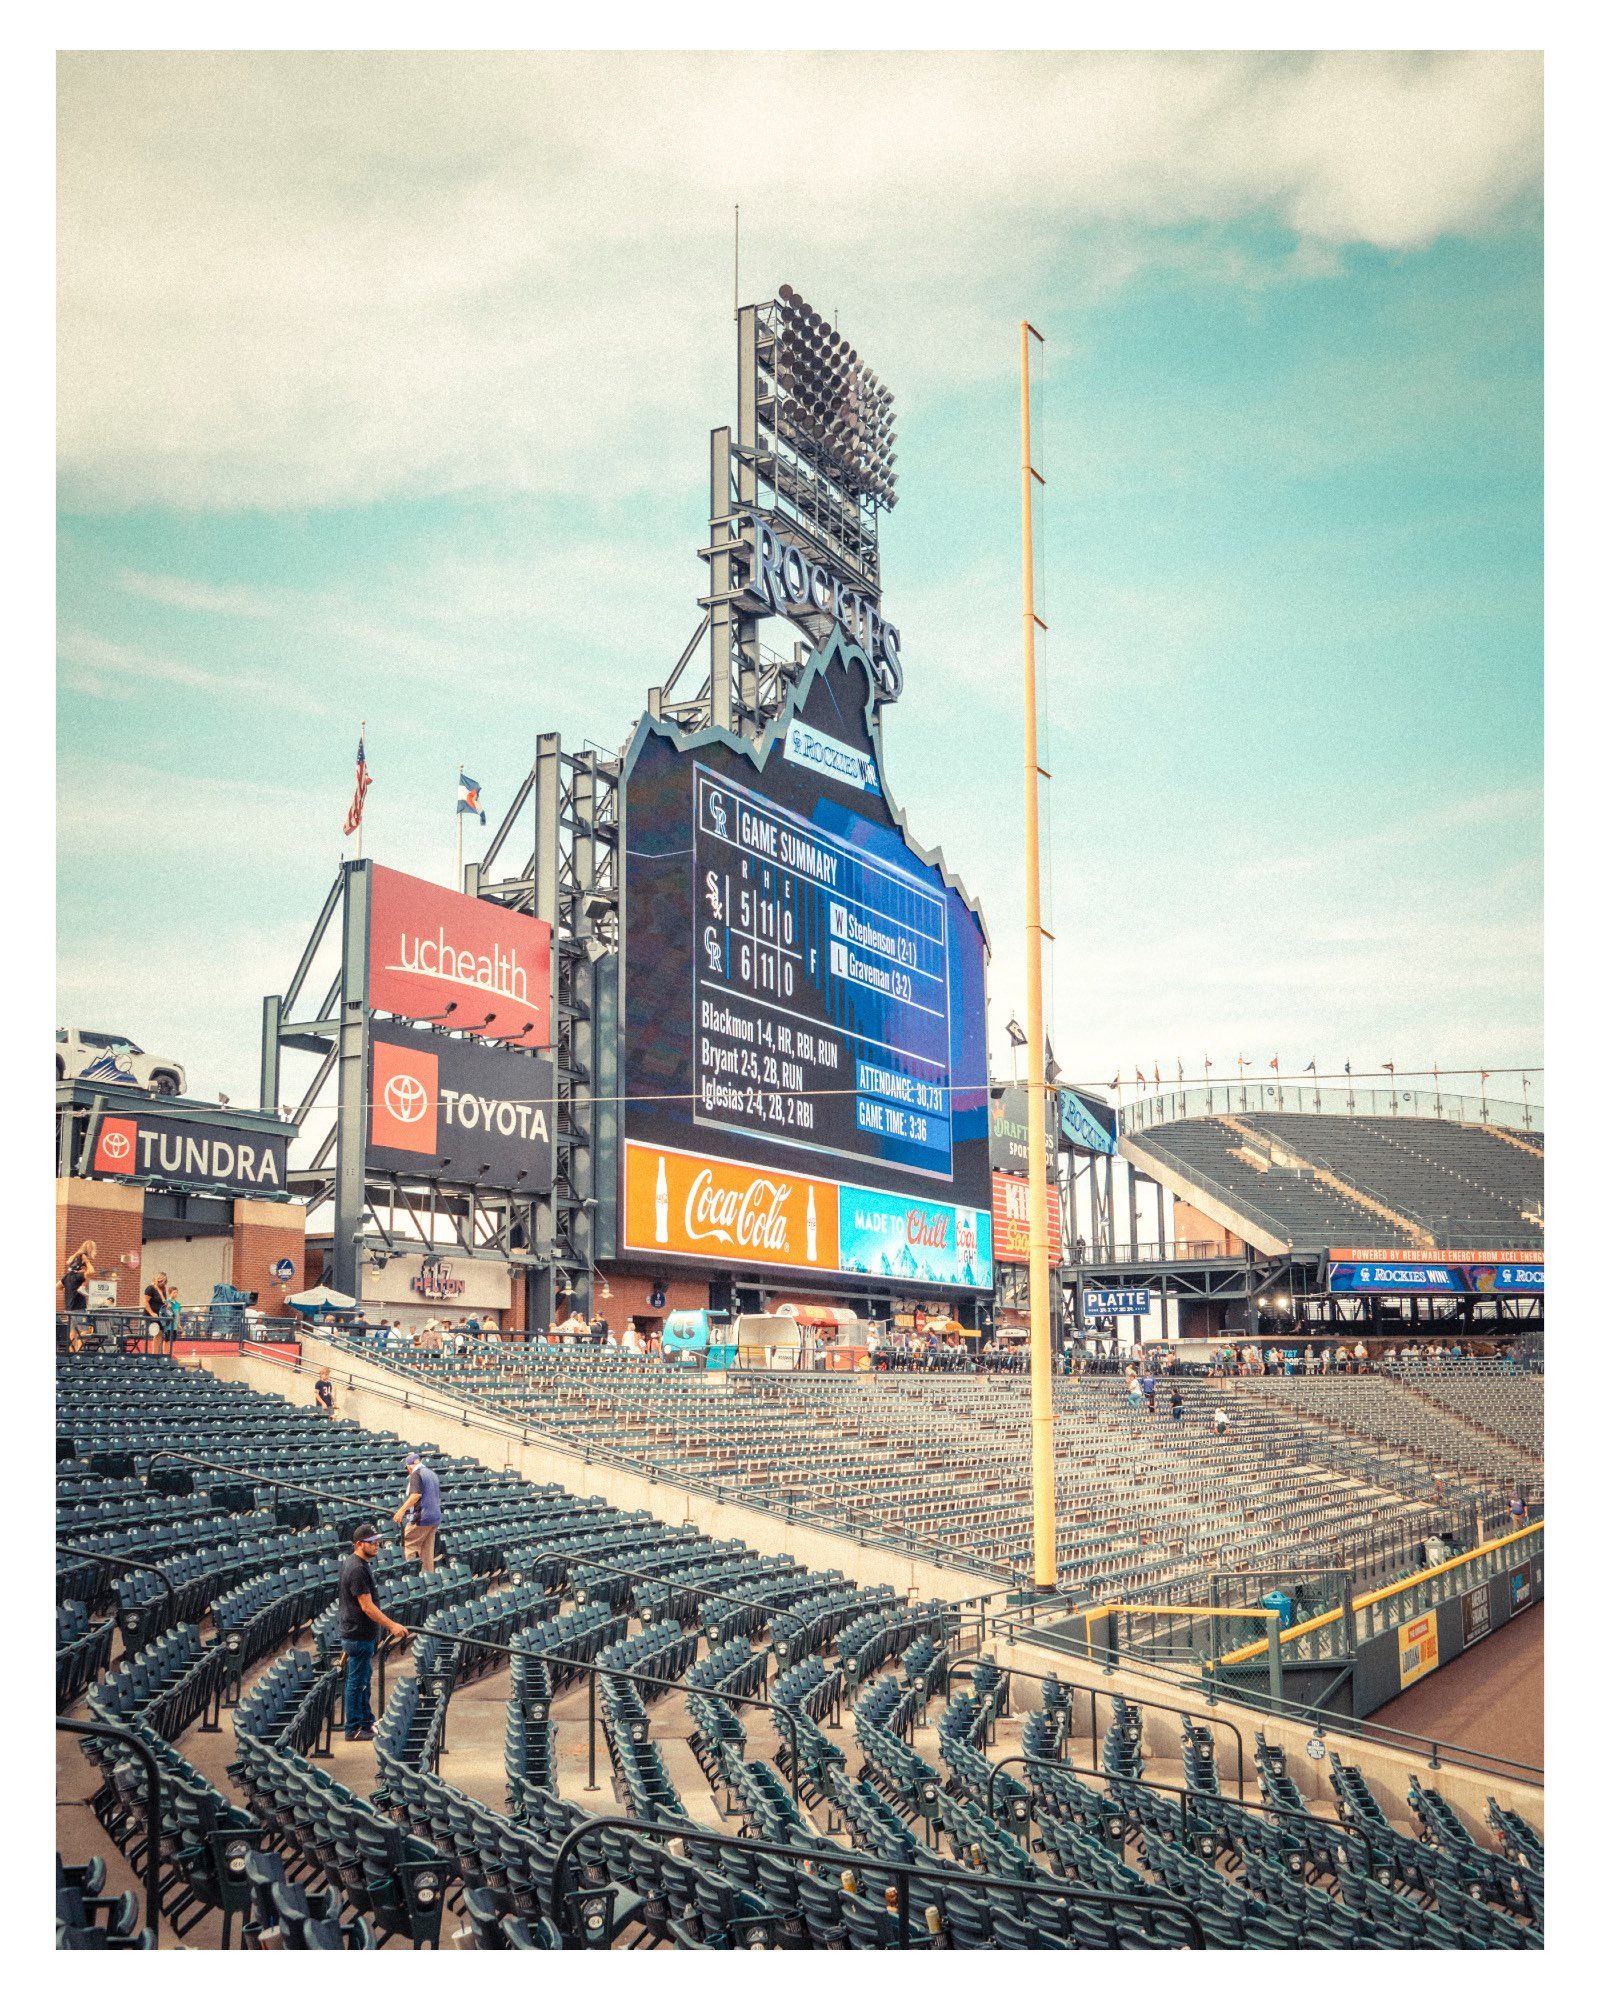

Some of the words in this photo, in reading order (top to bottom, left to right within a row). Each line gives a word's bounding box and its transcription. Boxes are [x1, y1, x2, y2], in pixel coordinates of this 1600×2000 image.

[749, 513, 904, 698] ROCKIES
[803, 733, 859, 778] ROCKIES
[742, 811, 778, 858] GAME
[780, 831, 838, 887] SUMMARY
[742, 859, 748, 879] R
[763, 869, 770, 889] H
[785, 879, 791, 899] E
[741, 890, 750, 927] 5
[760, 899, 774, 938] 11
[784, 909, 793, 945] 0
[835, 908, 845, 936] W
[848, 913, 896, 957] Stephenson
[897, 935, 917, 969] (2-1)
[401, 926, 528, 1002] uchealth
[741, 944, 751, 981] 6
[761, 952, 774, 990] 11
[784, 961, 793, 997] 0
[810, 947, 817, 974] F
[837, 947, 843, 974] L
[849, 952, 891, 991] Graveman
[892, 969, 912, 1004] (3-2)
[702, 1000, 754, 1043] Blackmon
[757, 1019, 777, 1054] 1-4,
[778, 1025, 795, 1060] HR,
[797, 1031, 817, 1066] RBI,
[818, 1038, 838, 1068] RUN
[702, 1037, 739, 1075] Bryant
[741, 1049, 761, 1084] 2-5,
[763, 1056, 780, 1090] 2B,
[782, 1061, 803, 1092] RUN
[860, 1064, 915, 1104] ATTENDANCE:
[916, 1082, 943, 1112] 30,731
[440, 1088, 549, 1143] TOYOTA
[702, 1075, 744, 1111] Iglesias
[746, 1086, 766, 1122] 2-4,
[769, 1094, 786, 1126] 2B,
[787, 1097, 795, 1124] 2
[797, 1100, 814, 1129] RBI
[859, 1101, 884, 1131] GAME
[885, 1108, 908, 1137] TIME:
[909, 1114, 927, 1142] 3:36
[138, 1129, 279, 1185] TUNDRA
[685, 1168, 792, 1250] Coca-Cola
[855, 1209, 888, 1233] MADE
[891, 1214, 905, 1234] TO
[906, 1207, 950, 1249] Chill
[1351, 1250, 1388, 1261] POWERED
[1390, 1250, 1401, 1261] BY
[1402, 1250, 1446, 1261] RENEWABLE
[1448, 1251, 1475, 1262] ENERGY
[1477, 1251, 1498, 1262] FROM
[1500, 1251, 1518, 1262] XCEL
[1374, 1268, 1427, 1283] ROCKIES
[1426, 1269, 1450, 1284] WIN!
[1087, 1291, 1146, 1307] PLATTE
